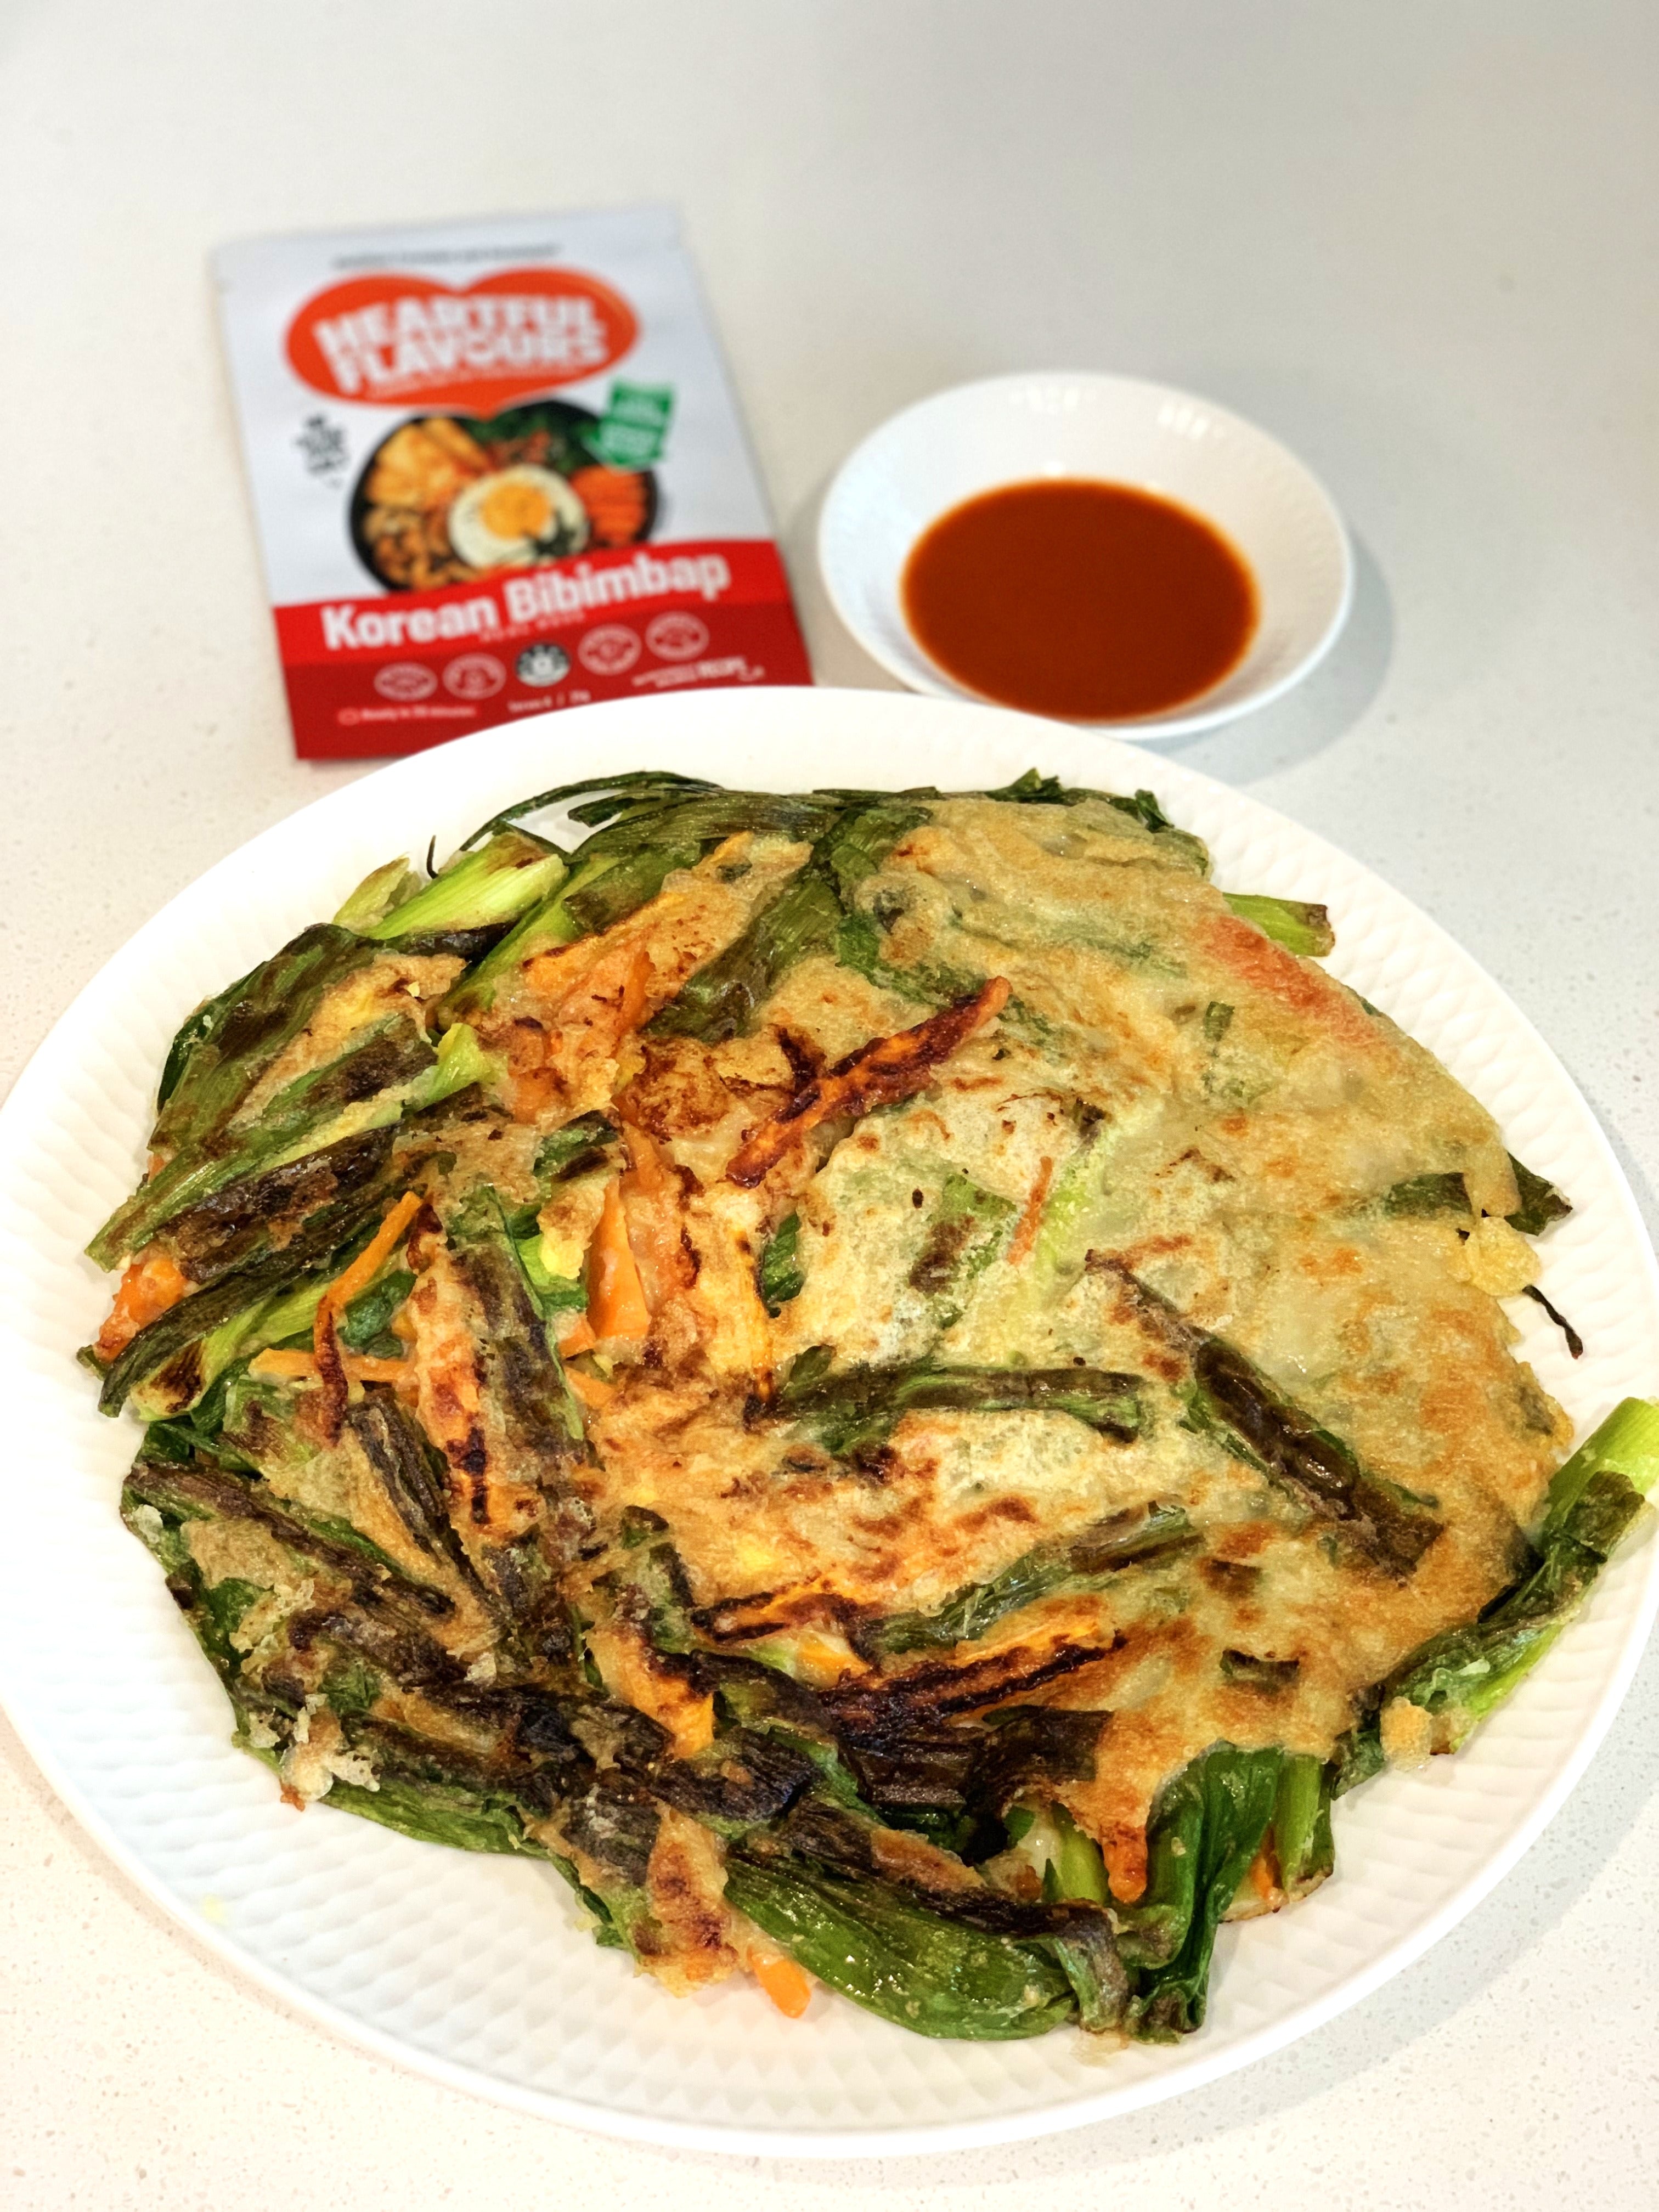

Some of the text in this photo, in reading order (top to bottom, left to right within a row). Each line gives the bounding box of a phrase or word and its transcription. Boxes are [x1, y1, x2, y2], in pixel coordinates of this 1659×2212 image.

[313, 295, 594, 353] HEARTFUL
[336, 321, 609, 393] FLAVOURS
[321, 597, 498, 650] Korean
[503, 552, 730, 623] Bibimbap
